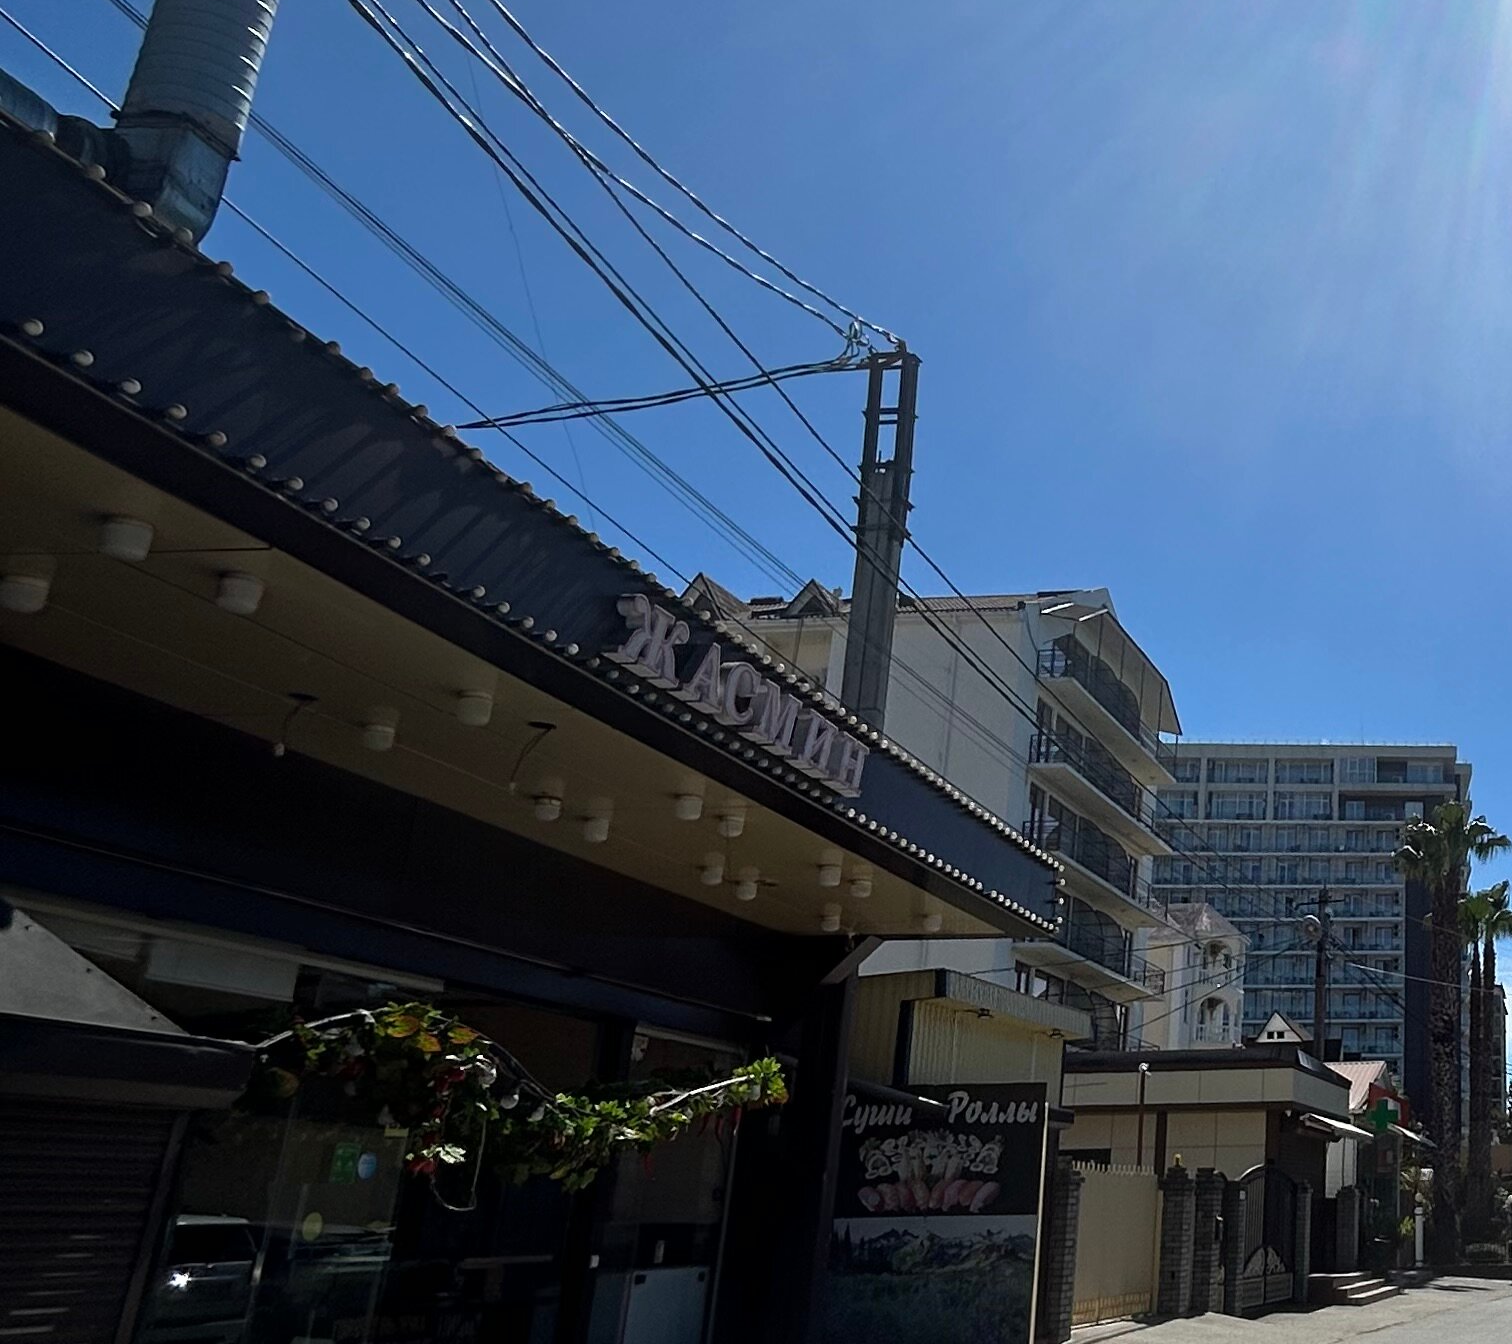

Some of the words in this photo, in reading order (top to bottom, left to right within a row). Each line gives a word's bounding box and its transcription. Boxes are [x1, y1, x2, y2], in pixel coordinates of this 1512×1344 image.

[603, 593, 870, 798] ЖАСМИН
[843, 1094, 912, 1134] Суши
[947, 1090, 1038, 1124] Роллы
